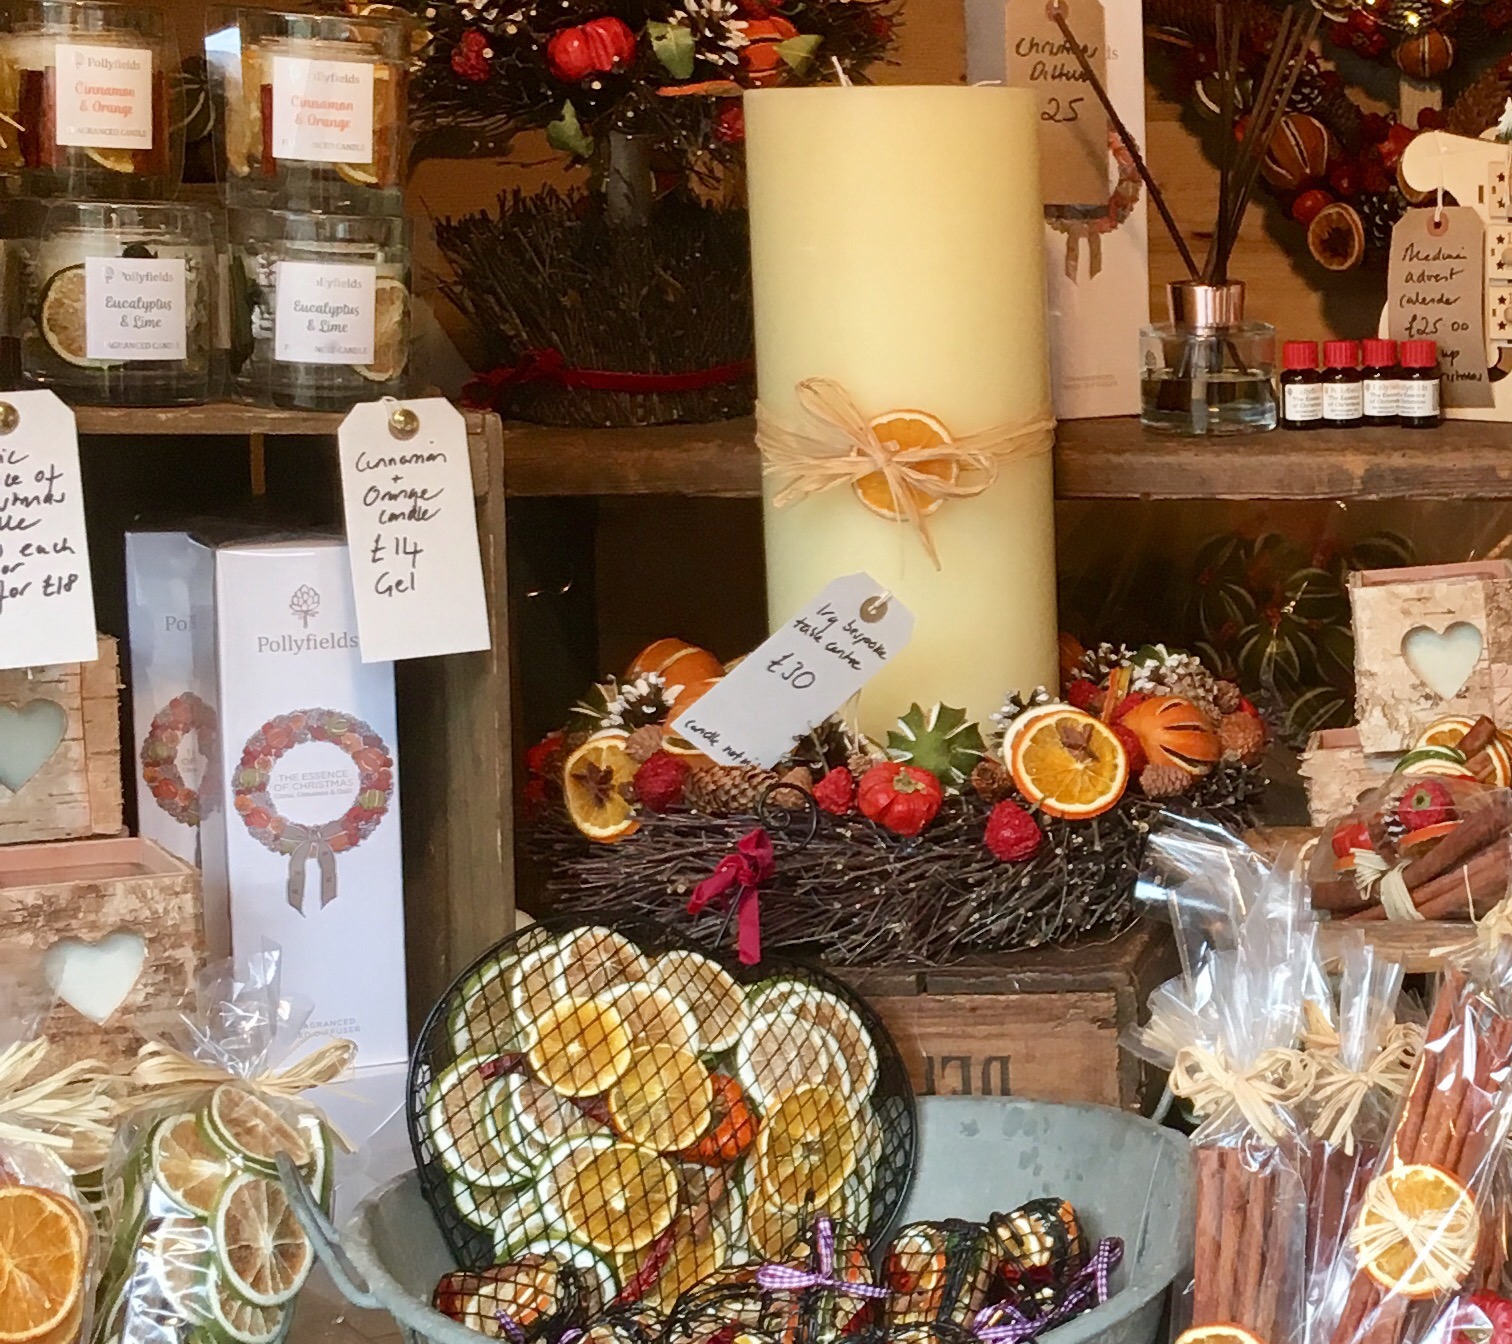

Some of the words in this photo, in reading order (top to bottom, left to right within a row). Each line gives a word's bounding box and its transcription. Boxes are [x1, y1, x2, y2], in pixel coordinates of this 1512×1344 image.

[1040, 97, 1084, 123] 25
[105, 295, 173, 314] Eucalyptus
[293, 299, 360, 318] Eucalyptus
[119, 314, 129, 328] &
[132, 314, 163, 330] Lime
[306, 318, 316, 332] &
[319, 319, 349, 334] Lime
[356, 450, 447, 473] Cinnamon
[391, 474, 404, 484] +
[363, 485, 445, 510] Orange
[19, 537, 76, 557] each
[371, 533, 423, 568] £14
[1, 562, 25, 575] or
[42, 573, 78, 597] £18
[374, 571, 415, 597] Gel
[257, 632, 359, 655] Pollyfields
[766, 652, 816, 689] £30
[273, 783, 289, 792] OF
[292, 778, 354, 791] CHRISTMAS
[278, 773, 299, 782] THE
[301, 769, 349, 781] ESSENCE
